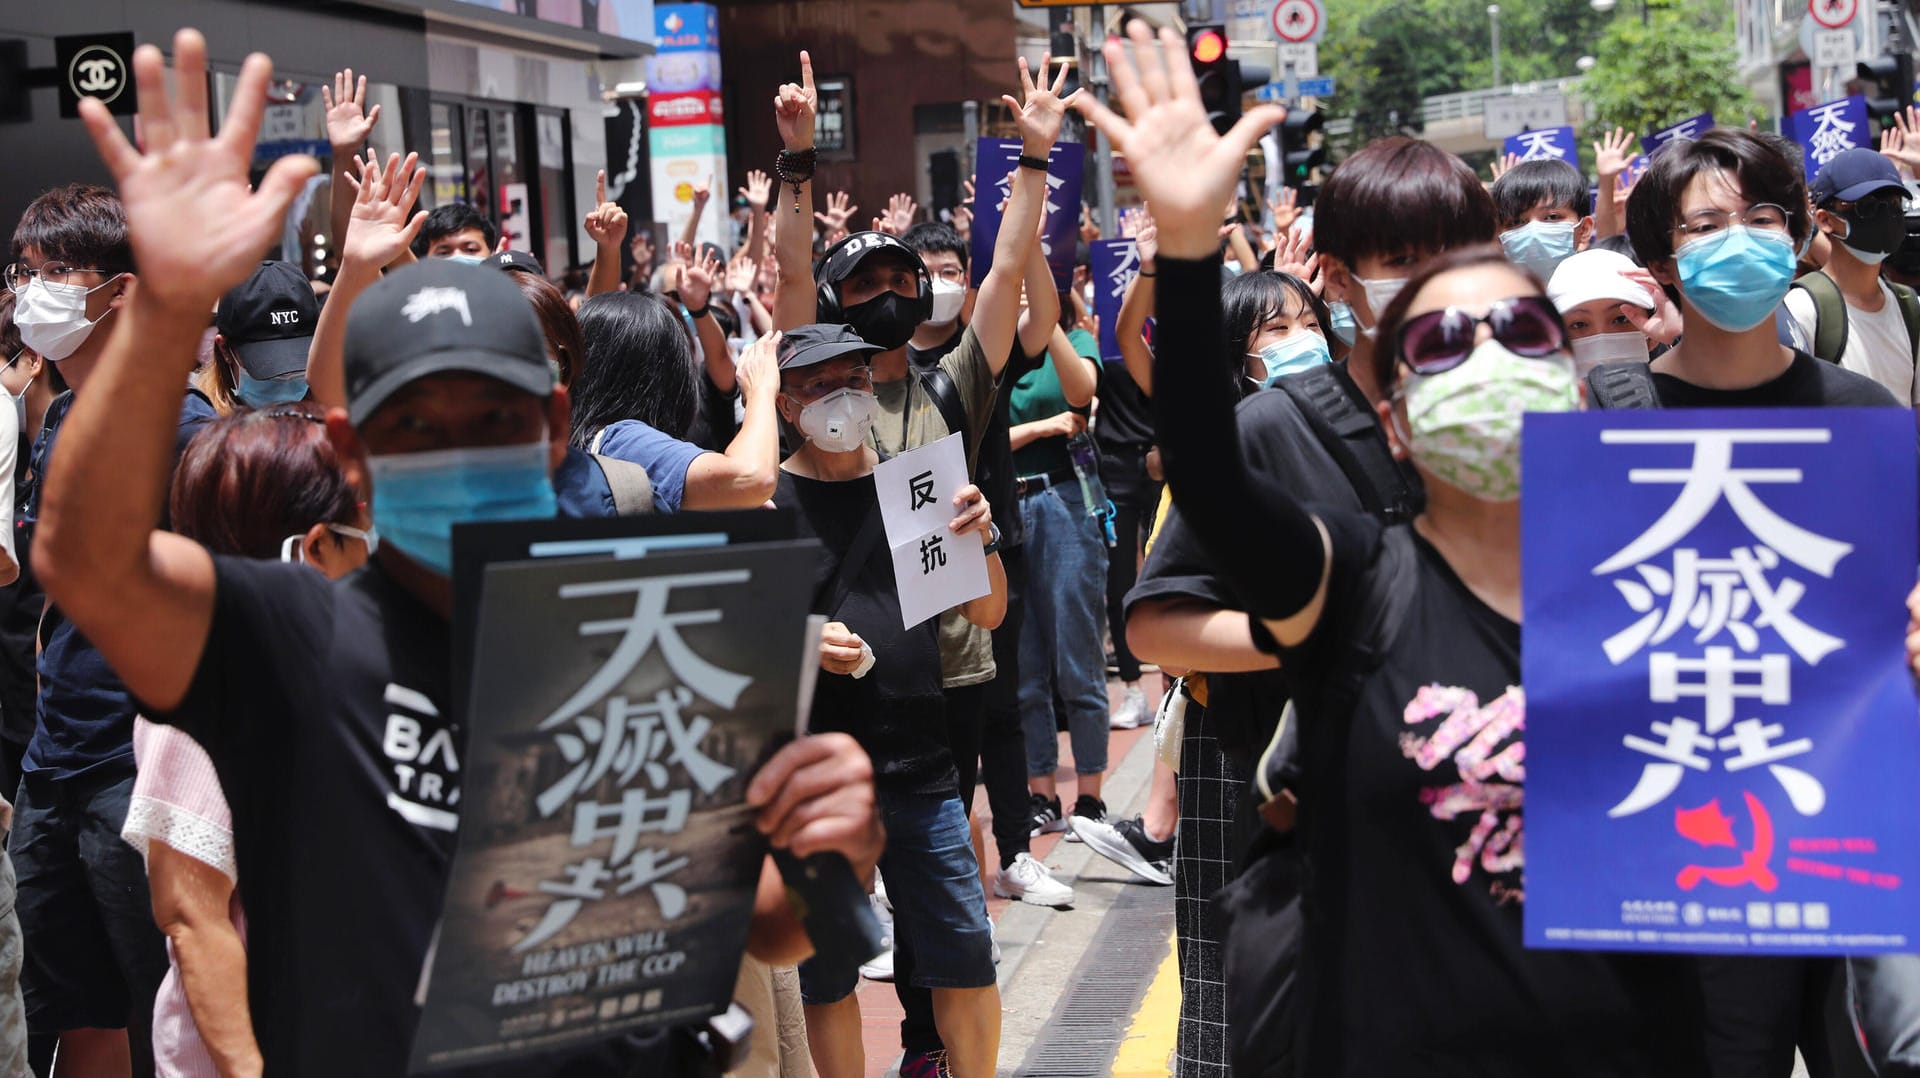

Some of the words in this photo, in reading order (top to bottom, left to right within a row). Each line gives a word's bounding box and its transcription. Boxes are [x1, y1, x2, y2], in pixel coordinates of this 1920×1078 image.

[270, 310, 299, 325] NYC
[909, 469, 947, 575] 反抗
[1591, 428, 1855, 819] 天滅中共
[511, 568, 754, 954] 天滅中共
[492, 972, 588, 1006] DESTROY
[597, 957, 641, 985] THE
[641, 951, 686, 979] CCP
[522, 943, 609, 976] HEAVEN
[615, 930, 666, 958] WILL
